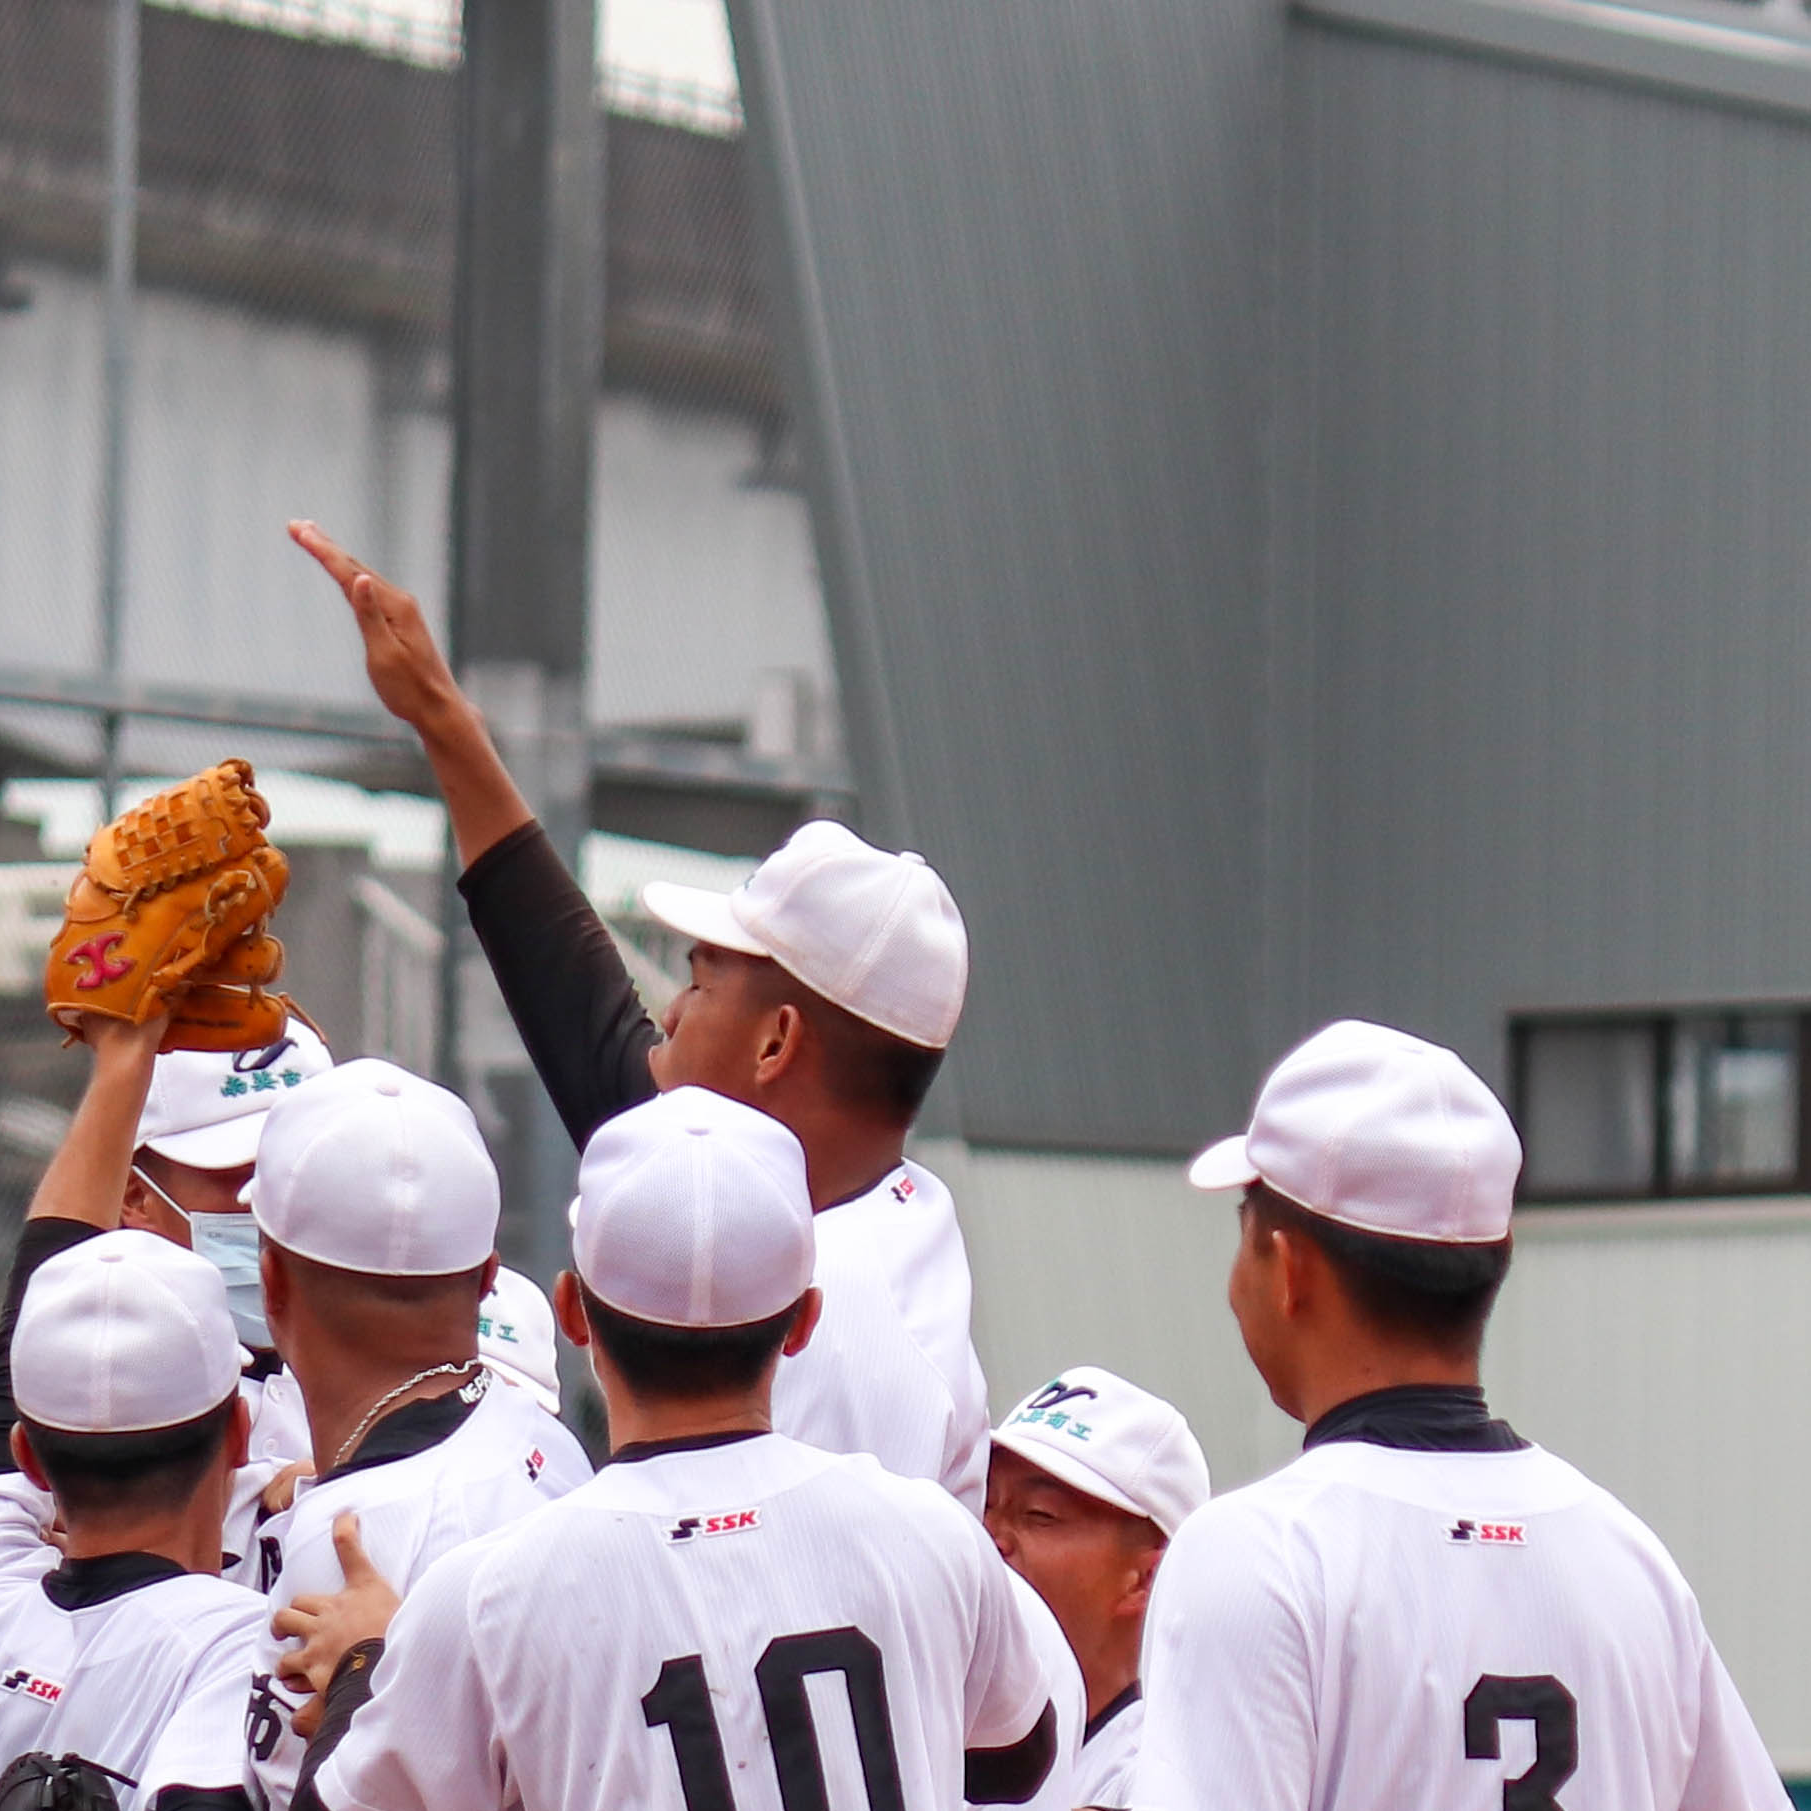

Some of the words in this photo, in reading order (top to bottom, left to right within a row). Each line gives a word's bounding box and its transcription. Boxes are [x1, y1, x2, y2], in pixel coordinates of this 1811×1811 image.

[705, 1509, 757, 1533] SSK
[1480, 1524, 1525, 1541] SSK
[25, 1679, 63, 1702] SSK
